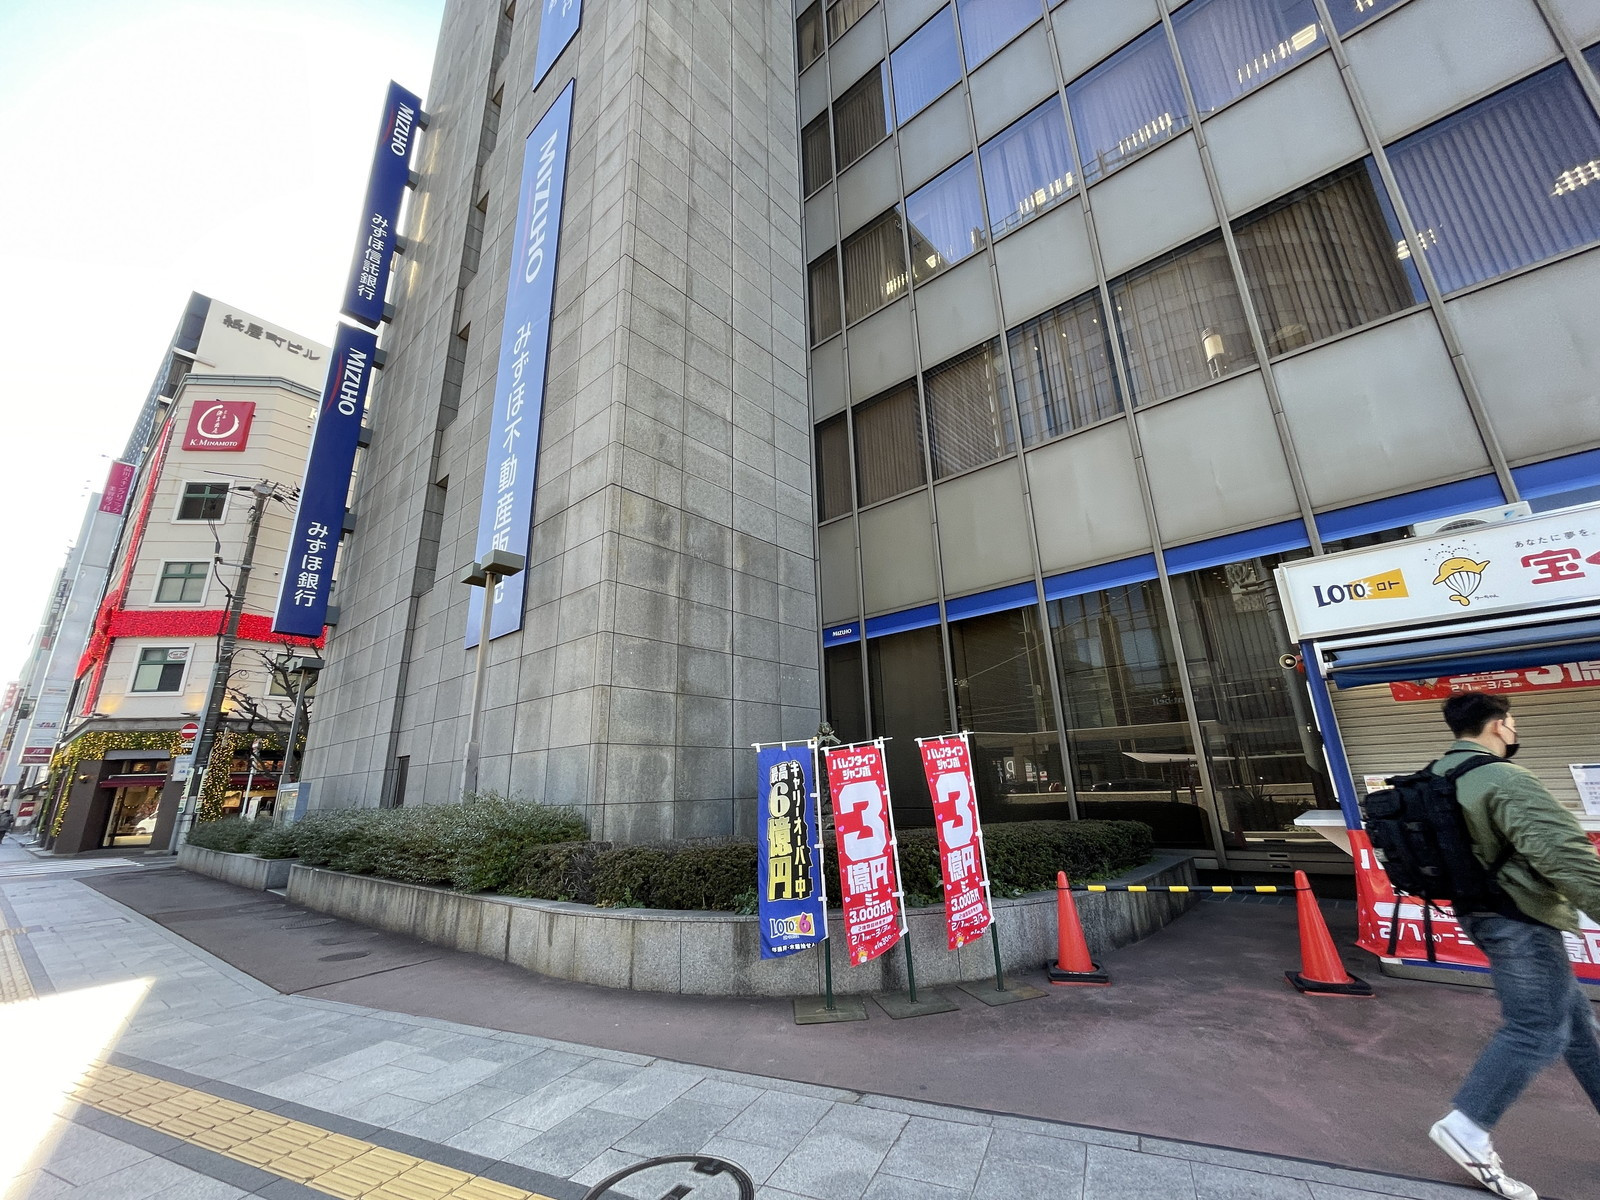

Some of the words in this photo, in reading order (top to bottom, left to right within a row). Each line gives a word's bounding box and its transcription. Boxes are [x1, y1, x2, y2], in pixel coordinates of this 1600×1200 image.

[391, 103, 414, 156] MIZUHO
[525, 128, 558, 284] MIZUHO
[357, 213, 388, 301] みずほ信託銀行
[223, 314, 321, 361] 紙屋町ビル
[337, 347, 367, 417] MIZUHO
[490, 321, 532, 605] みずほ不動産販
[1514, 528, 1596, 549] あなたに夢を。
[294, 521, 328, 607] みずほ銀行
[1312, 583, 1366, 608] LOTO
[832, 753, 876, 770] バレンタイン
[842, 765, 872, 780] ジャンボ
[927, 746, 964, 760] バレンタイン
[936, 757, 961, 770] ジャンボ
[790, 761, 806, 899] キャリーオーバー中
[846, 856, 889, 895] 億円
